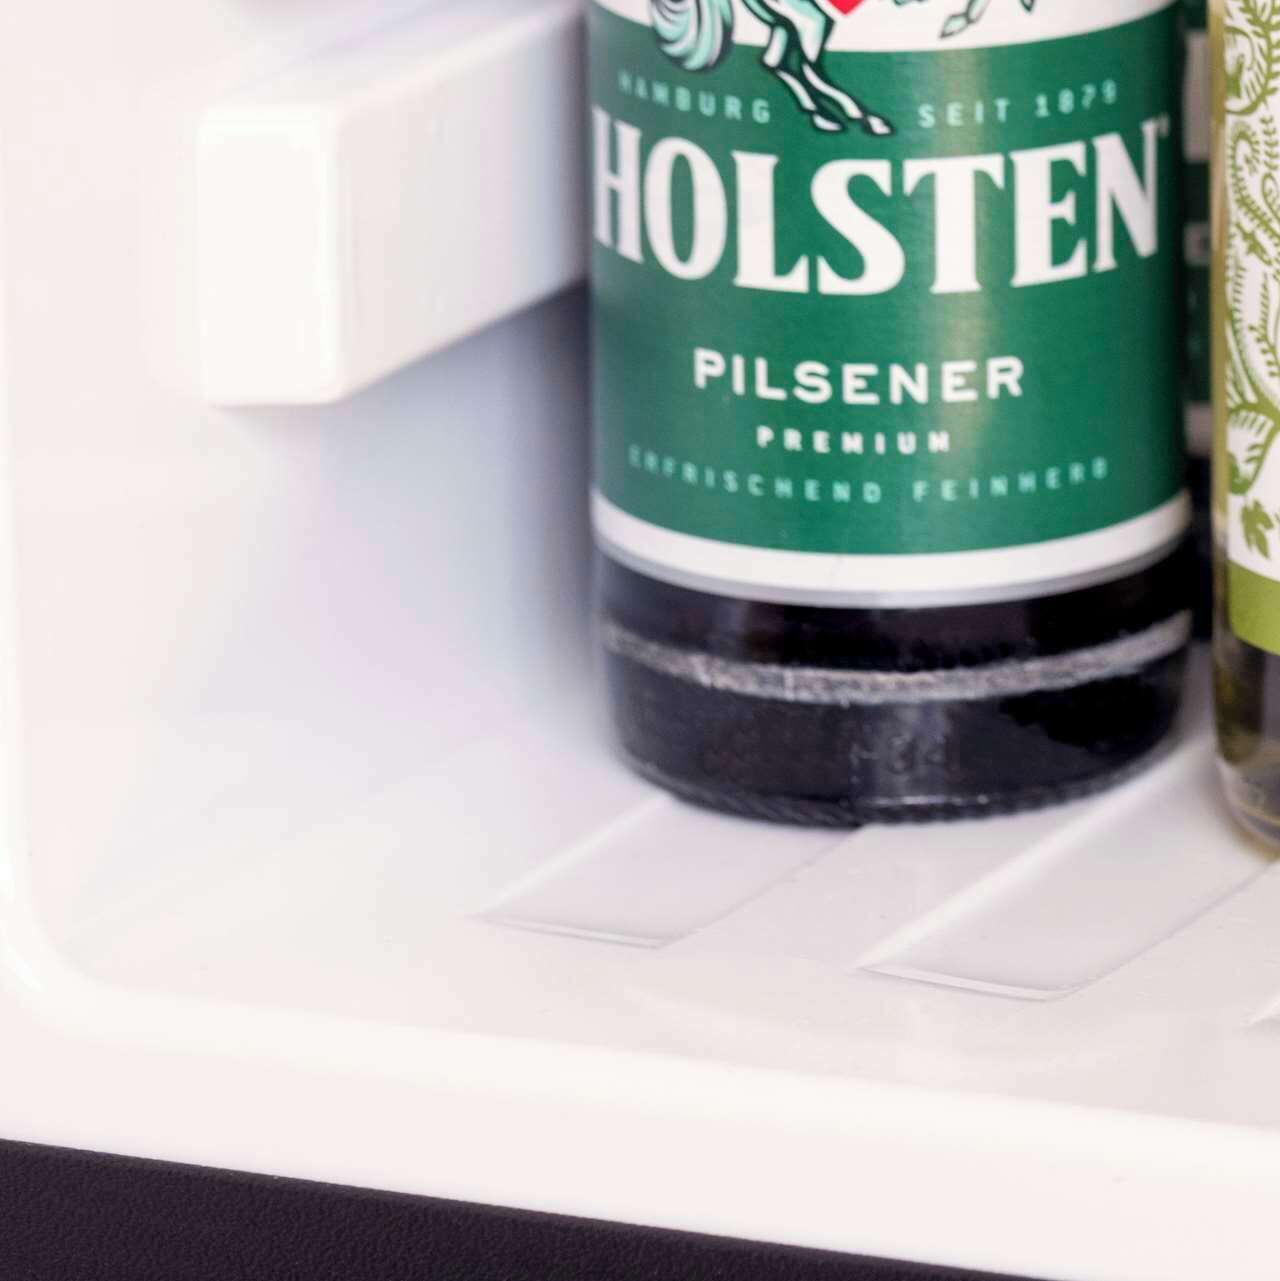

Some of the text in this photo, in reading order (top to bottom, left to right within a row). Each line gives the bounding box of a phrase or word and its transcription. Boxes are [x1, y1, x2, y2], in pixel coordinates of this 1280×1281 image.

[618, 70, 1118, 128] HAMBURG SEIT 1879
[593, 104, 1157, 296] HOLSTEN
[693, 348, 1025, 405] PILSENER
[756, 426, 950, 455] PREMIUM
[628, 445, 1108, 504] ERFRISCHEND FEINHERB
